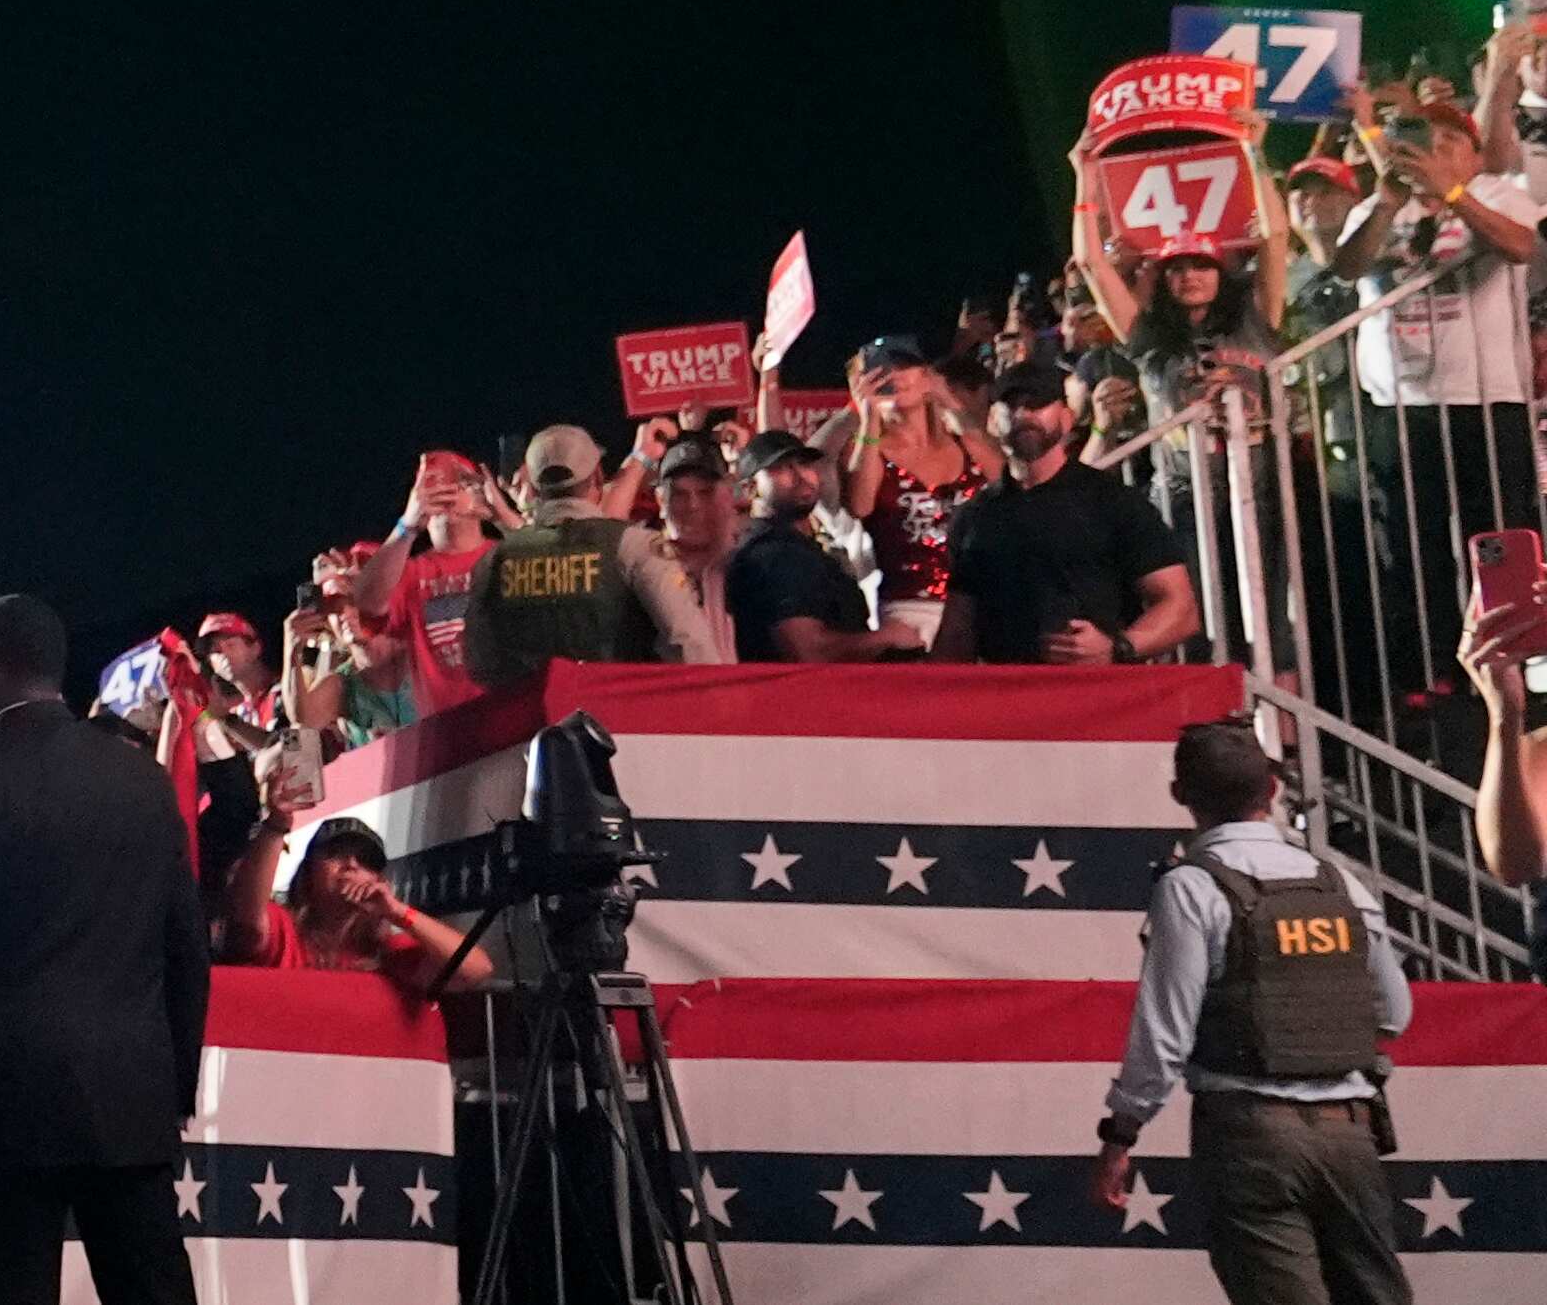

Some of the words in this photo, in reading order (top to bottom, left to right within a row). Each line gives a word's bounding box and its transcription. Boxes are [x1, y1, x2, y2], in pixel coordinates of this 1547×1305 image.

[1094, 73, 1244, 115] TRUMP
[1101, 90, 1225, 121] VANCE
[1122, 156, 1239, 239] 47
[626, 343, 742, 374] TRUMP
[643, 362, 732, 388] VANCE
[502, 553, 603, 598] SHERIFF
[101, 645, 162, 705] 47
[1276, 917, 1351, 955] HSI
